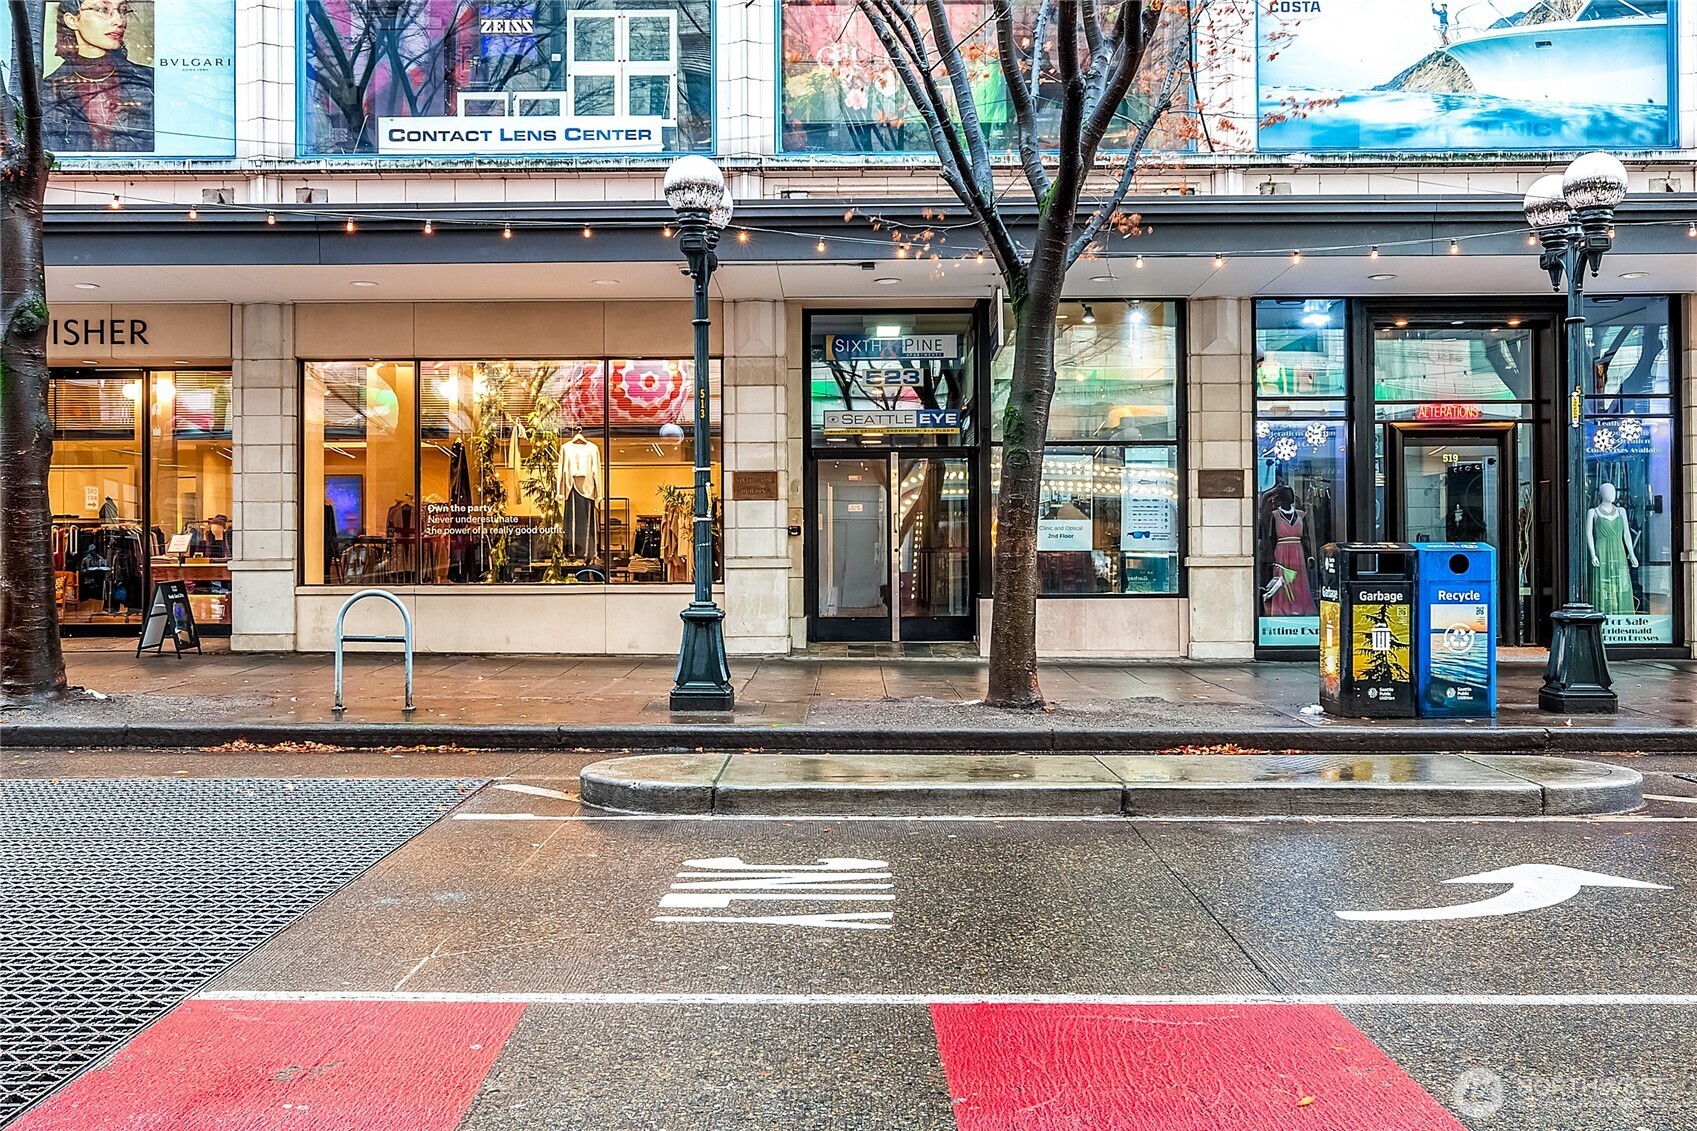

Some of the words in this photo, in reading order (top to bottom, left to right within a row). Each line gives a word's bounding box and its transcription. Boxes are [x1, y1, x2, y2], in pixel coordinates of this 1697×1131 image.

[1270, 1, 1321, 12] COSTA
[480, 19, 534, 34] ZEISS
[160, 58, 231, 66] BVLGARI
[388, 128, 492, 142] CONTACT
[500, 128, 557, 141] LENS
[564, 127, 652, 141] CENTER
[53, 319, 149, 345] ISHER
[835, 339, 882, 352] SIXTH
[880, 340, 904, 359] &
[904, 339, 943, 351] PINE
[866, 370, 920, 384] 523
[1418, 405, 1479, 418] ALTERATIONS
[841, 414, 914, 424] SEATTLE
[919, 413, 957, 424] EYE
[1442, 453, 1459, 463] 519
[427, 504, 449, 513] Own
[450, 504, 466, 512] the
[467, 504, 495, 514] party.
[427, 515, 453, 523] Never
[455, 515, 519, 523] underestimate
[428, 526, 441, 535] the
[472, 526, 481, 534] of
[489, 526, 514, 535] really
[515, 526, 538, 535] good
[540, 526, 566, 534] outfit.
[1359, 591, 1403, 602] Garbage
[1438, 590, 1480, 602] Recycle
[1625, 618, 1649, 626] Sale
[1262, 627, 1299, 635] Fitting
